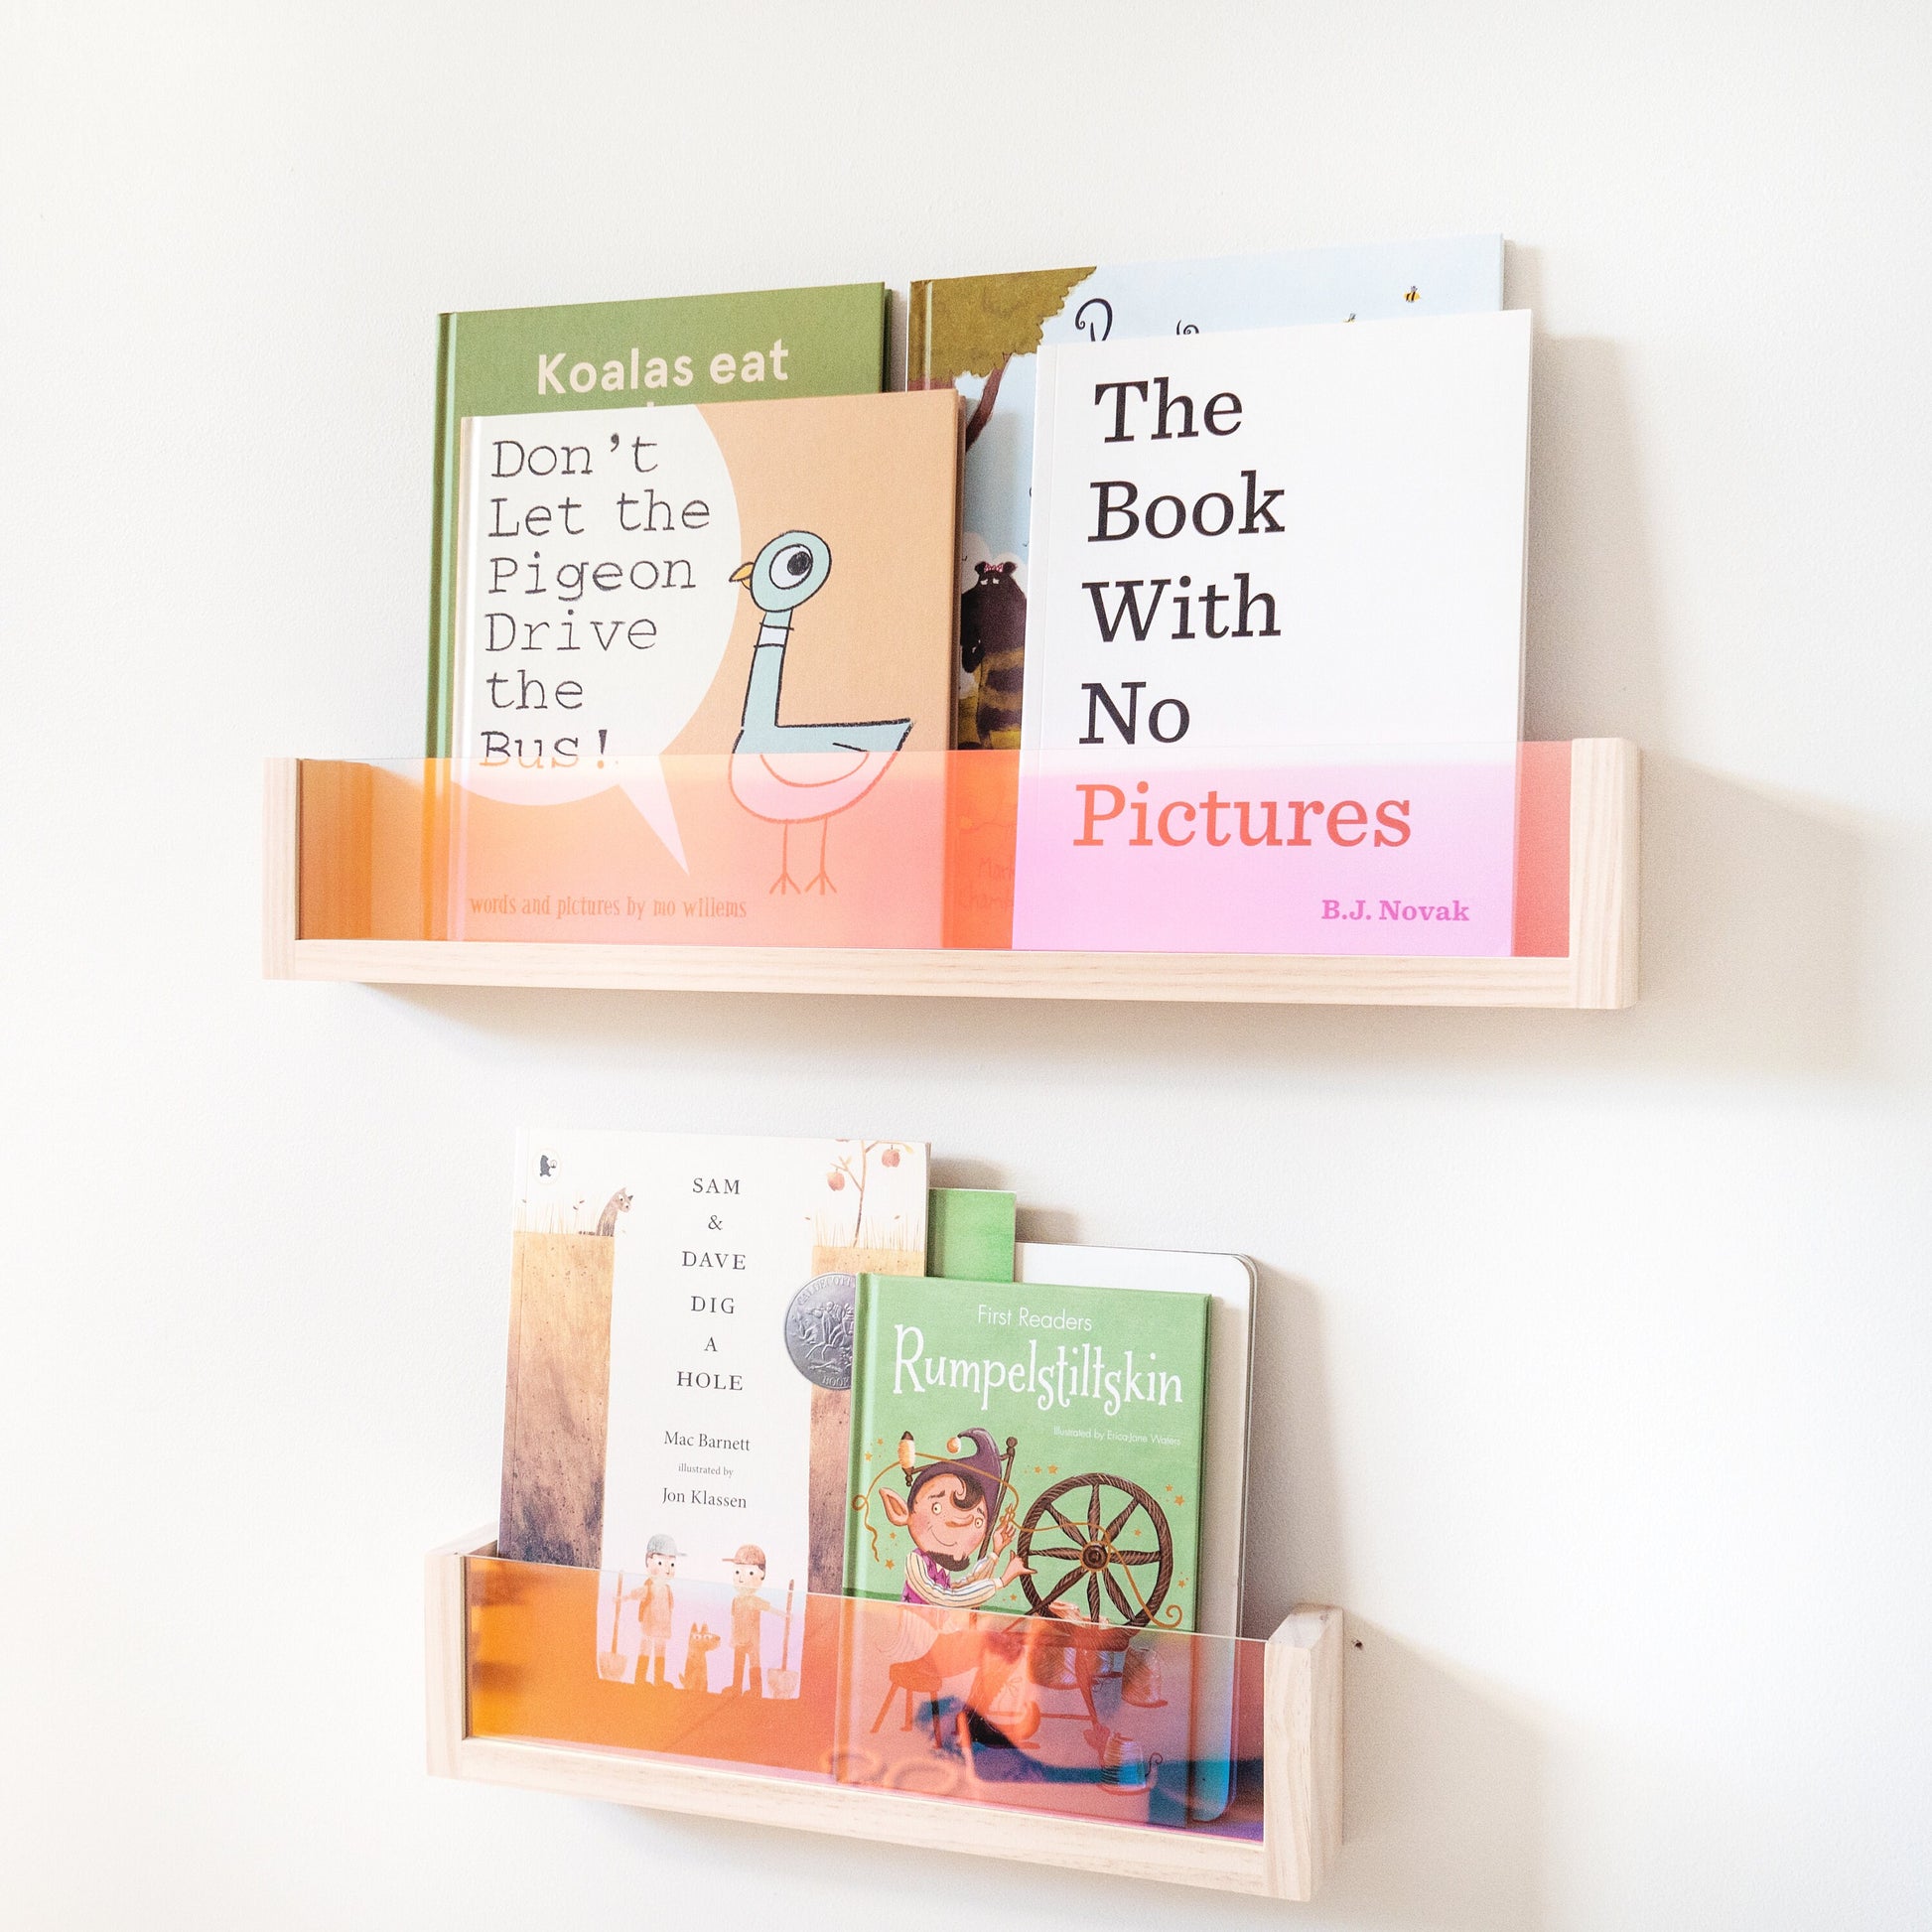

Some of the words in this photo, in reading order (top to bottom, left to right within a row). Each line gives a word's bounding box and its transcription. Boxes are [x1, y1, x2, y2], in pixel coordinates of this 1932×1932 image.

[537, 347, 694, 395] Koalas
[709, 338, 789, 384] eat
[1094, 376, 1243, 444] The
[490, 433, 658, 478] Don't
[487, 496, 585, 538] Let
[616, 489, 711, 532] the
[1087, 470, 1286, 543] Book
[487, 551, 697, 602] Pigeon
[1081, 572, 1282, 643] With
[484, 610, 657, 652] Drive
[485, 669, 584, 710] the
[1078, 681, 1190, 746] No
[479, 729, 609, 769] Bus!
[1072, 780, 1412, 848] Pictures
[469, 895, 516, 914] words
[522, 896, 551, 914] and
[556, 896, 621, 919] pictures
[626, 897, 645, 920] by
[653, 899, 676, 916] mo
[683, 897, 747, 918] willems
[1320, 899, 1372, 921] B.J.
[1378, 899, 1470, 922] Novak
[692, 1177, 741, 1195] SAM
[708, 1214, 723, 1231] &
[682, 1251, 747, 1271] DAVE
[690, 1296, 736, 1314] DIG
[978, 1304, 1013, 1325] First
[1019, 1307, 1093, 1332] Readers
[704, 1336, 718, 1352] A
[677, 1371, 744, 1391] HOLE
[893, 1323, 1183, 1417] Rumpelstiltskin
[663, 1430, 694, 1447] Mac
[698, 1433, 751, 1451] Barnett
[1053, 1426, 1092, 1439] Illustrated
[1093, 1428, 1105, 1442] by
[678, 1463, 720, 1476] illustrated
[722, 1466, 734, 1478] by
[662, 1486, 685, 1504] Jon
[691, 1489, 748, 1508] Klassen
